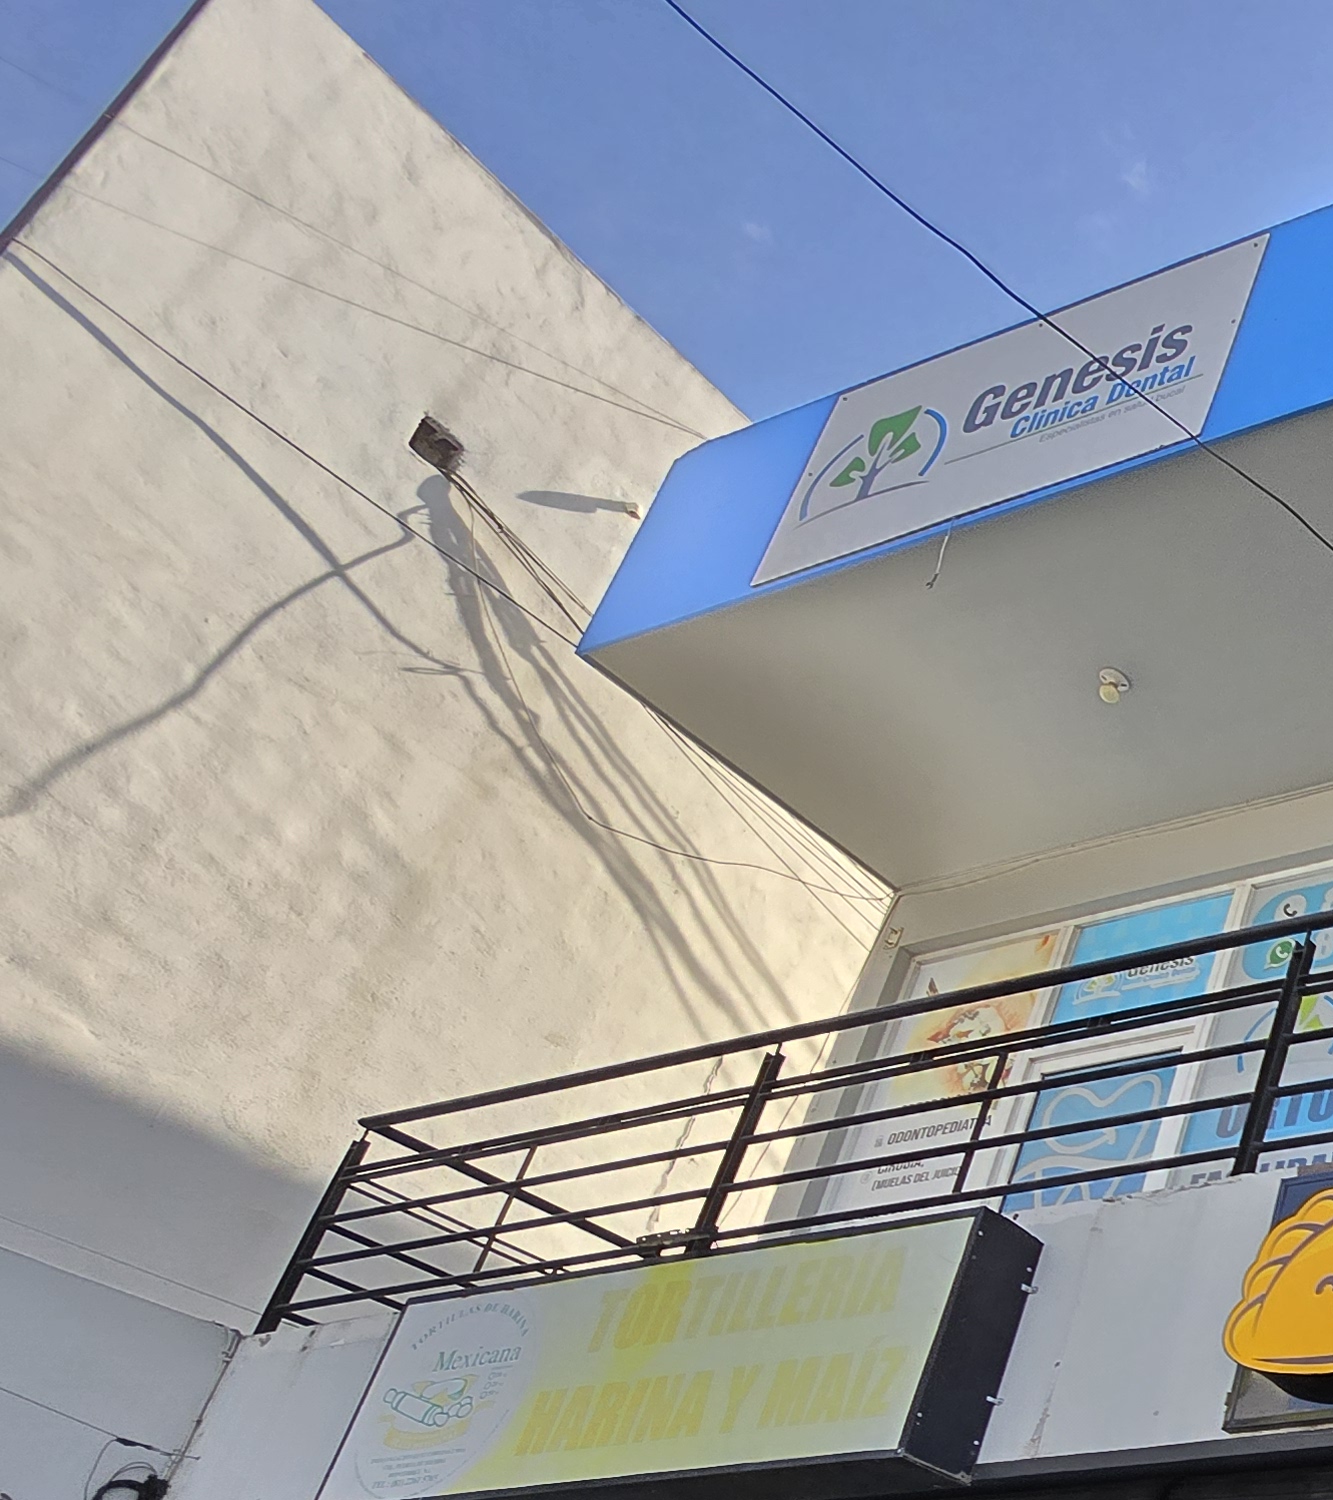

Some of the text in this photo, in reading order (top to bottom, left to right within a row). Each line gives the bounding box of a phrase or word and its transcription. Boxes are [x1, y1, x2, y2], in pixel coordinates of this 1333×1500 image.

[962, 324, 1193, 433] Genesis
[1106, 356, 1196, 405] Dental
[888, 1114, 992, 1145] ODONTOPEDIATA
[588, 1240, 908, 1354] TORTILLERÍA
[432, 1345, 522, 1373] Mexicana
[514, 1334, 909, 1457] HARINA Y MAÍZ
